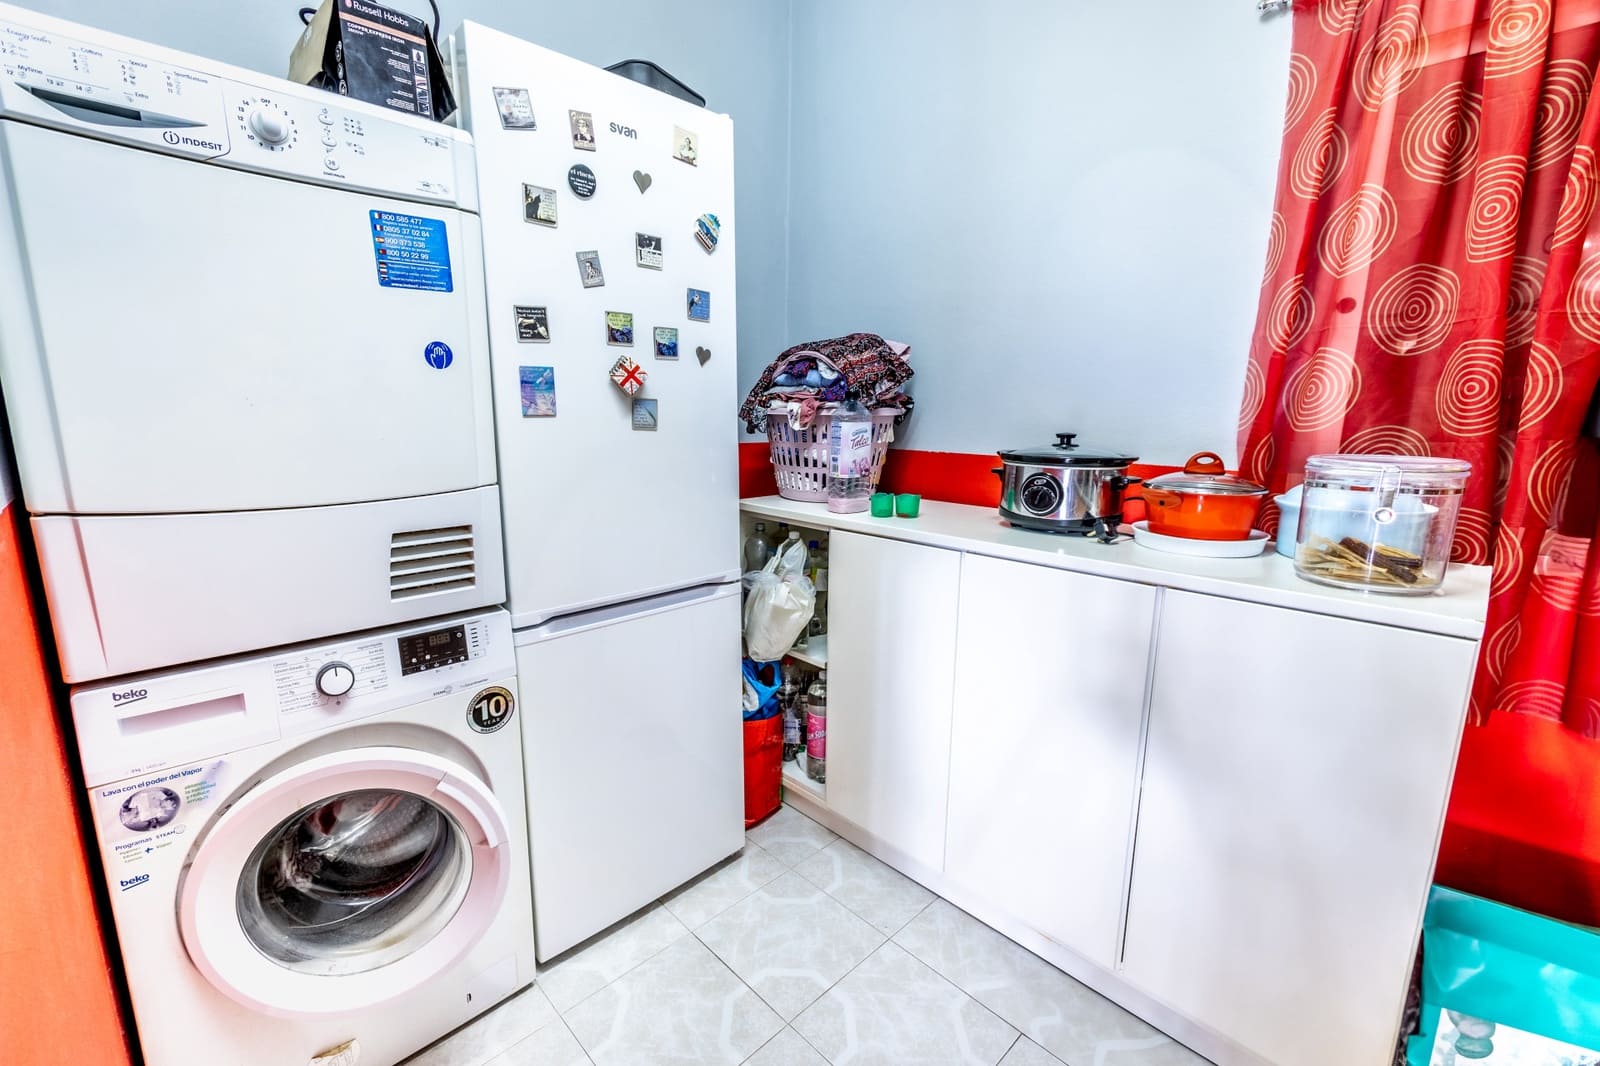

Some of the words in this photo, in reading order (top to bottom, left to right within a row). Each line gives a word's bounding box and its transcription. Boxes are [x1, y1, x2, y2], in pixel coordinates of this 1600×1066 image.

[353, 1, 382, 18] Russell
[383, 11, 409, 27] Hobbs
[609, 121, 638, 140] svan
[182, 136, 223, 151] INDESIT
[410, 251, 420, 259] 22
[111, 689, 148, 704] beko
[475, 695, 508, 721] 10
[483, 717, 500, 726] YEAR
[102, 788, 121, 797] Lava
[122, 785, 137, 793] con
[137, 781, 145, 789] el
[146, 775, 168, 787] poder
[169, 772, 181, 781] del
[181, 767, 203, 777] Vapor
[115, 837, 153, 852] Programas
[120, 873, 150, 889] beko
